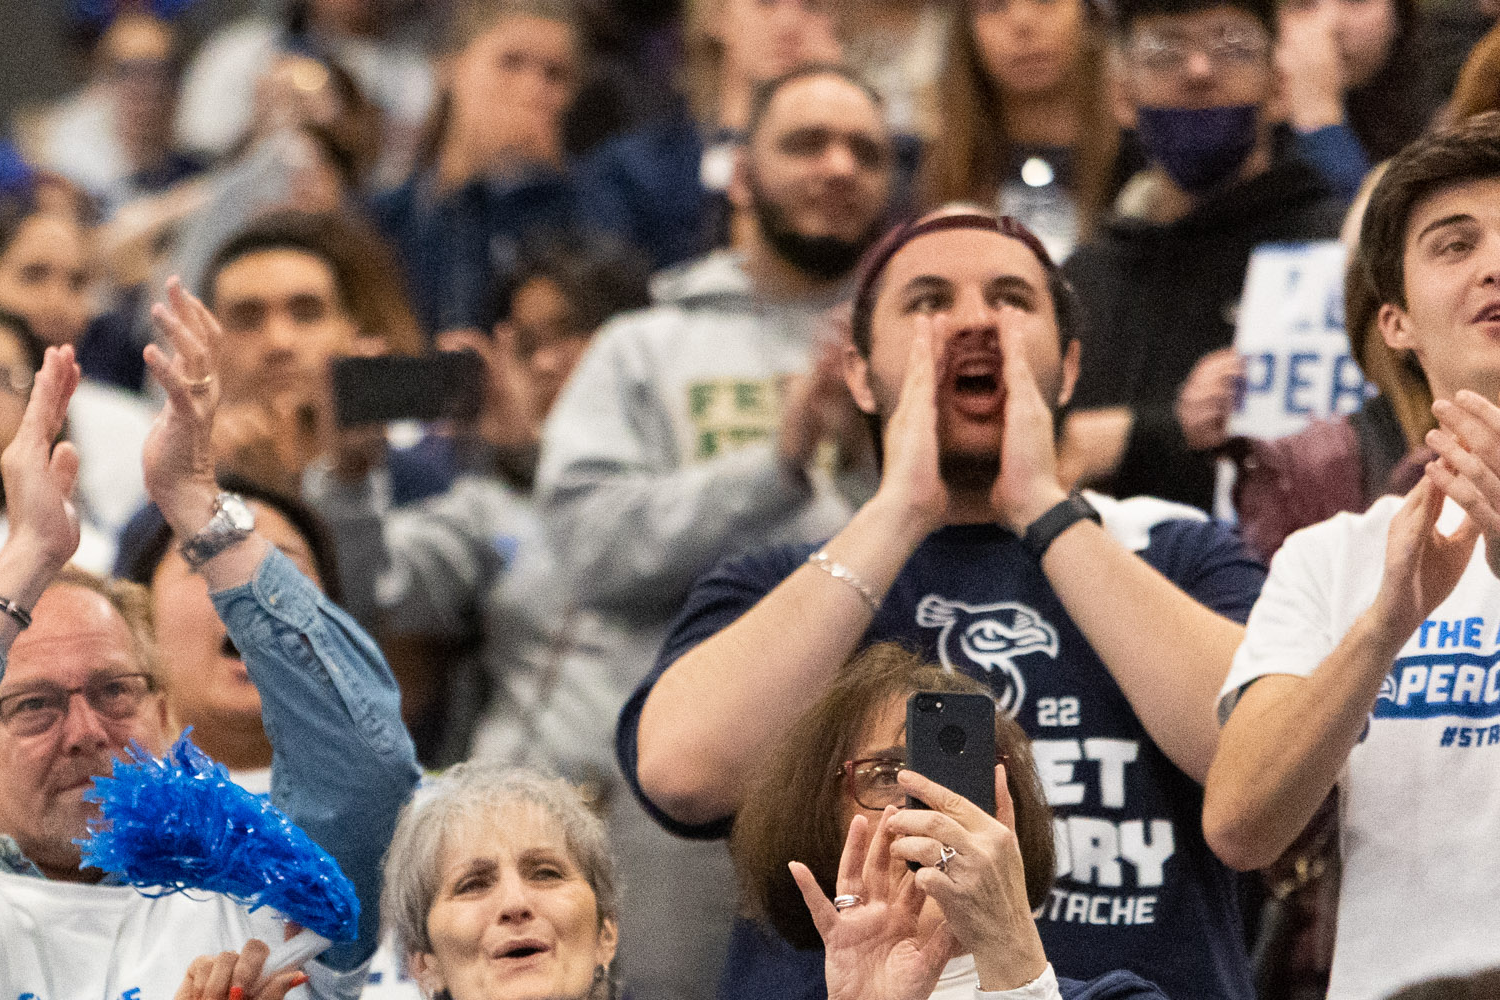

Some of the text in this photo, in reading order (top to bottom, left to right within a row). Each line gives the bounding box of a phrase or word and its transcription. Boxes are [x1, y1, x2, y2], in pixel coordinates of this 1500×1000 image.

[1231, 352, 1367, 414] PEA
[1418, 616, 1485, 649] THE
[1031, 737, 1139, 809] ET
[1034, 887, 1158, 925] TACHE
